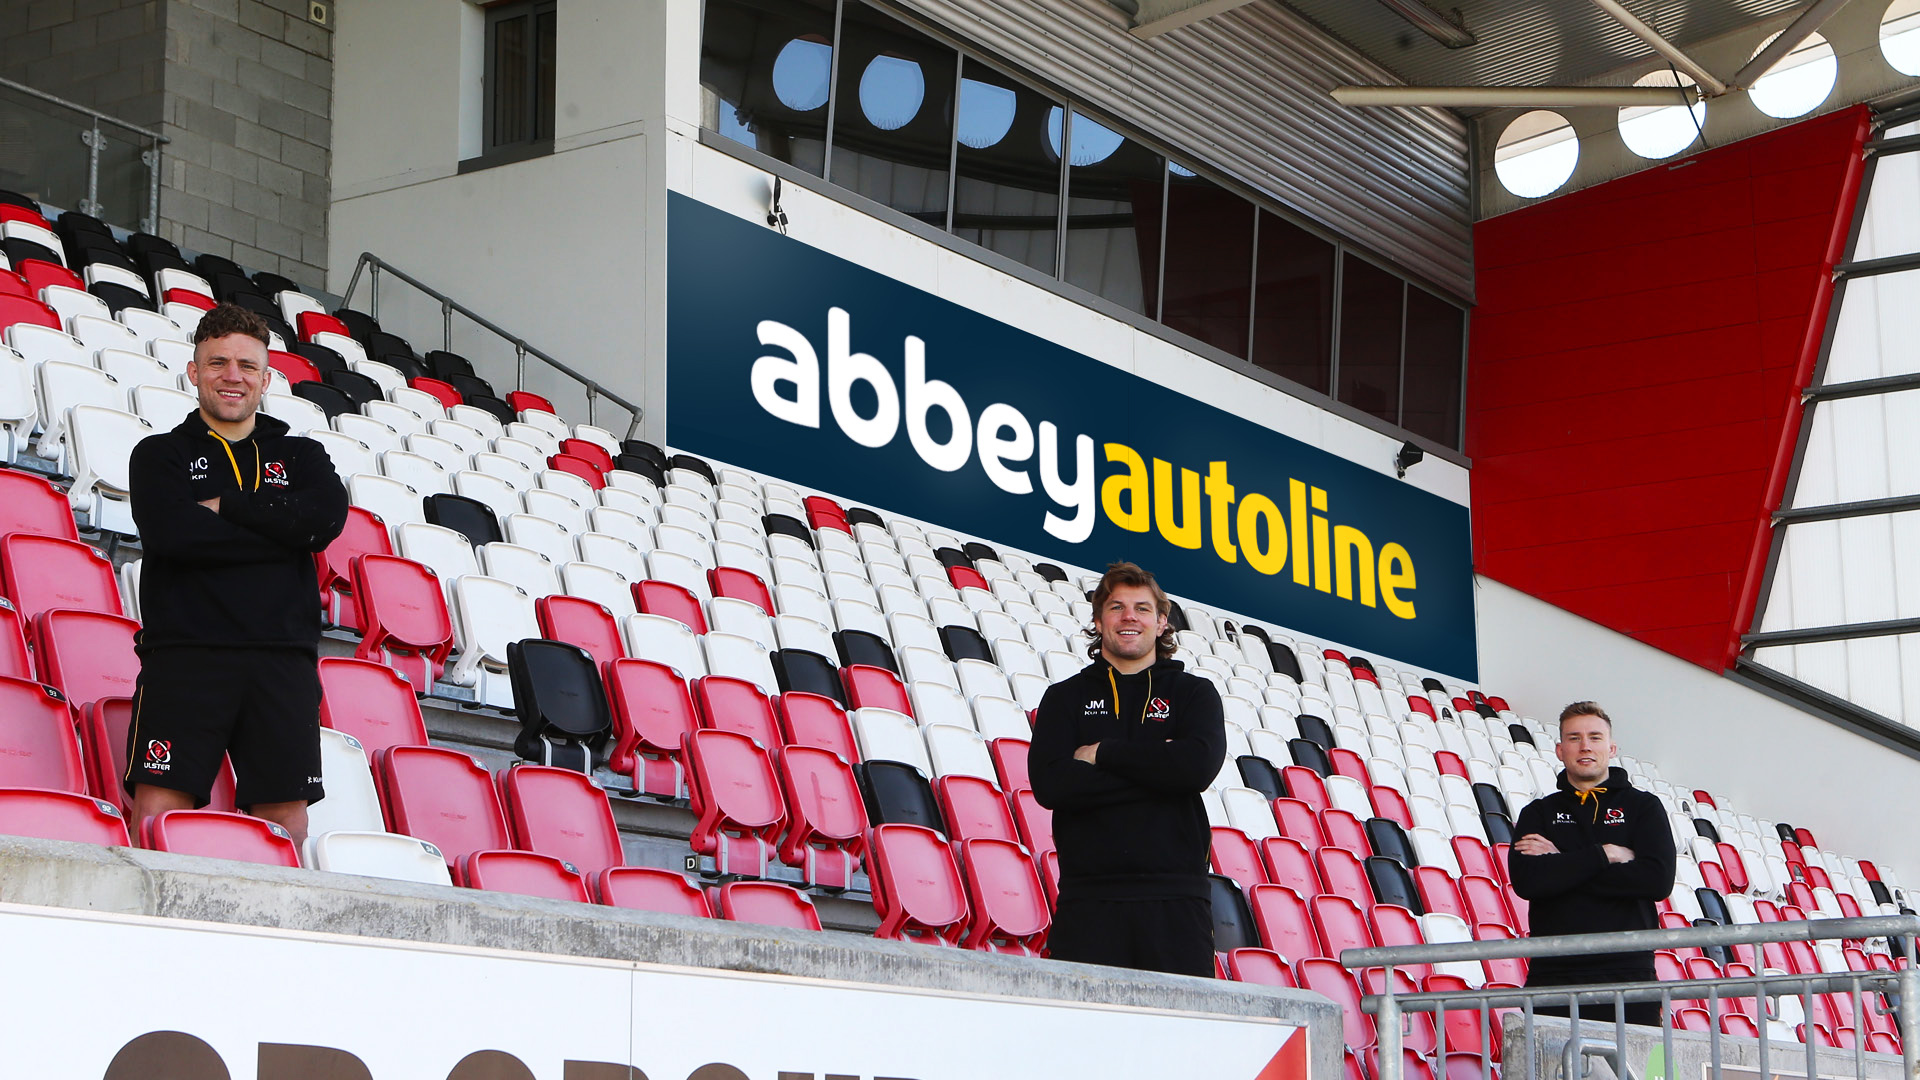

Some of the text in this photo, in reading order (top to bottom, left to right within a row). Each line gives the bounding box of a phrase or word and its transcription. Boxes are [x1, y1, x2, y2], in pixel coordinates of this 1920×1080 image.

[264, 477, 289, 486] ULSTER
[1085, 699, 1105, 710] JM
[143, 762, 171, 771] ULSTER
[102, 804, 112, 813] 92
[1556, 812, 1572, 820] KT
[273, 826, 282, 835] 93
[686, 858, 696, 869] D
